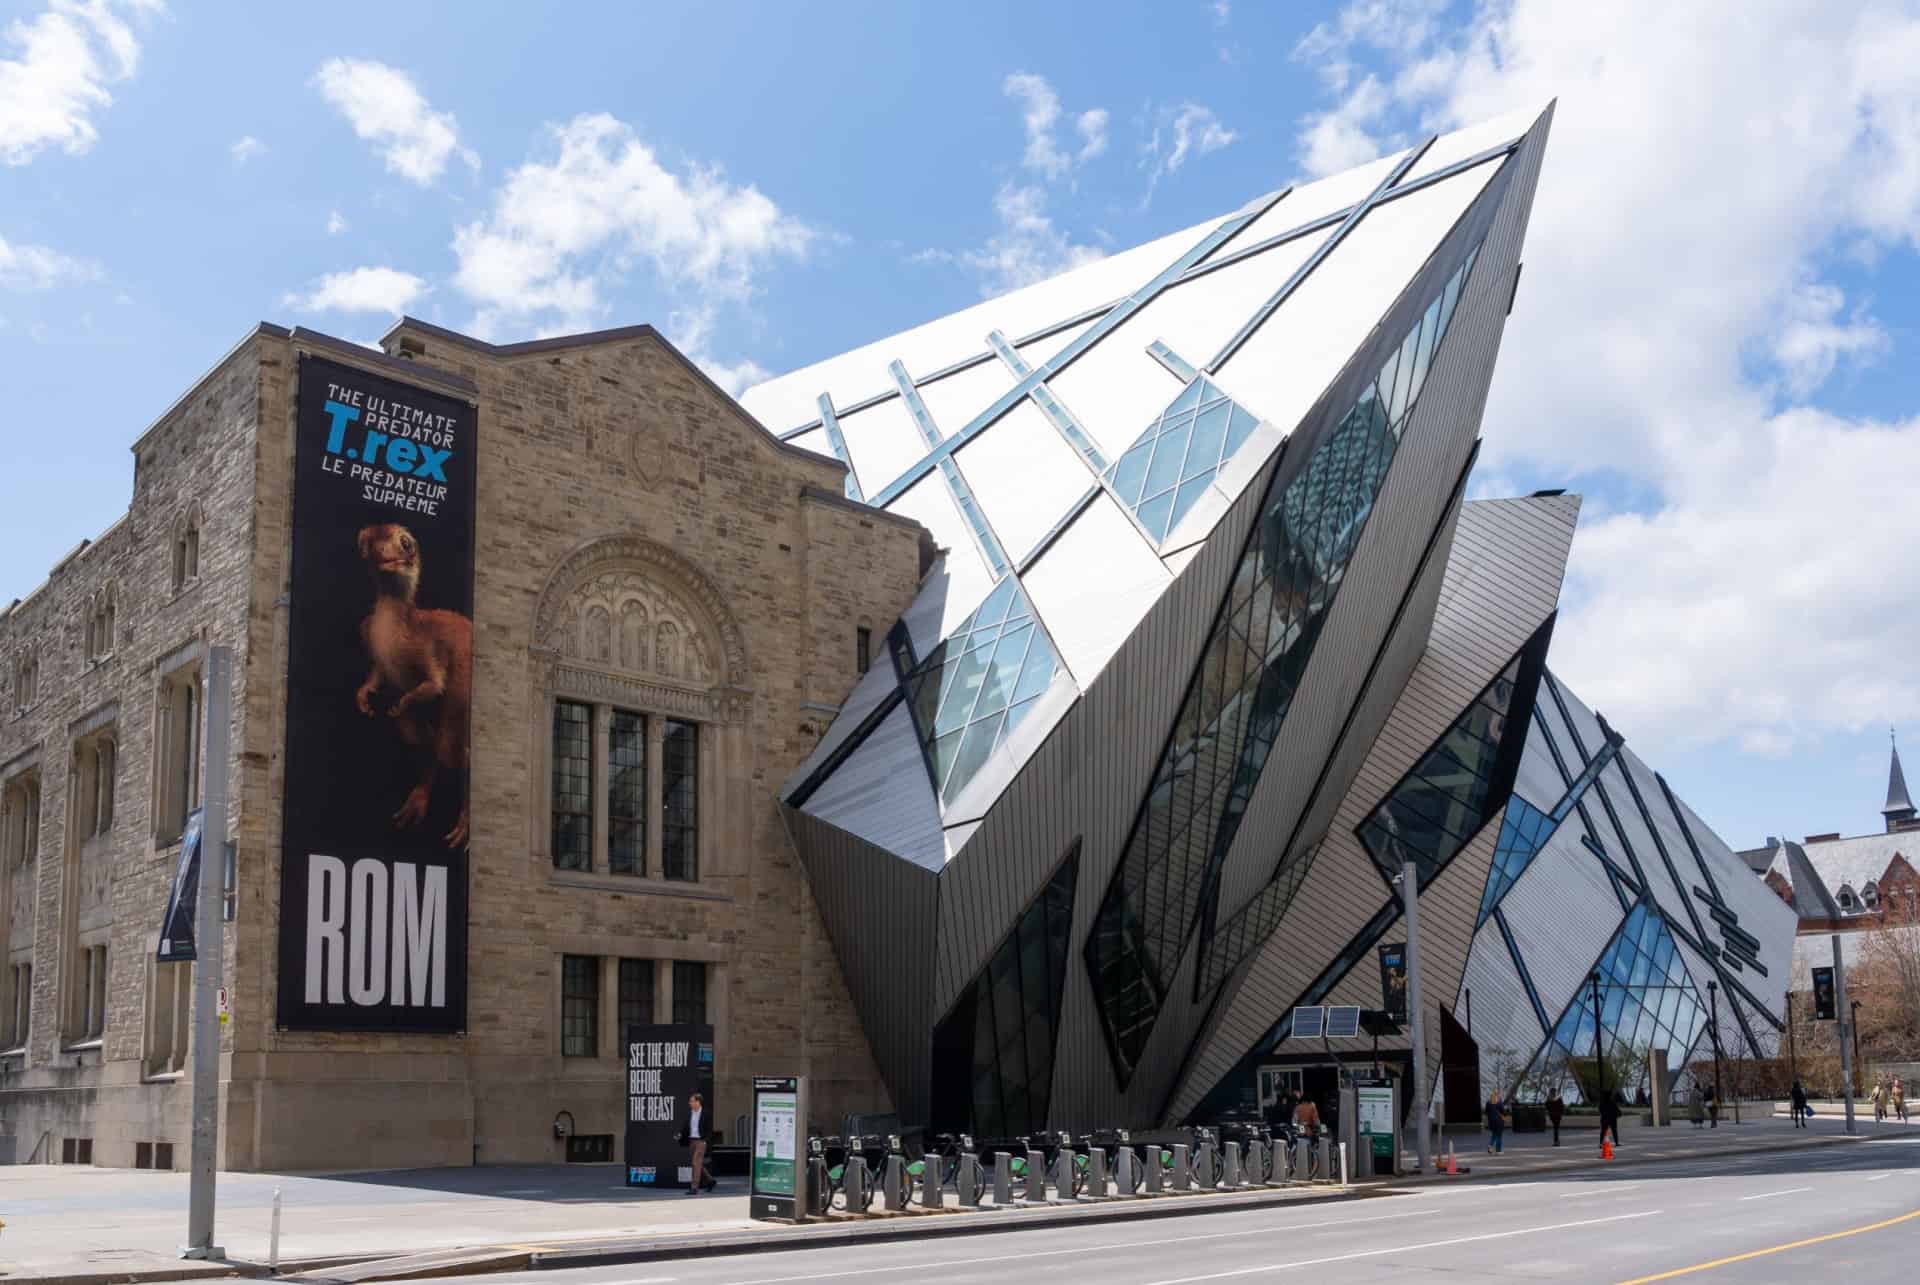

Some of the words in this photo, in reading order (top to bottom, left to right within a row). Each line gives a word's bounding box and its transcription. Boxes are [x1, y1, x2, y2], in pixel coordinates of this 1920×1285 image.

[328, 383, 364, 407] THE
[367, 396, 456, 433] ULTIMATE
[324, 400, 452, 482] T.rex
[365, 413, 453, 448] PREDATOR
[322, 456, 345, 474] LE
[350, 464, 447, 501] PRÉDATEUR
[362, 485, 438, 515] SUPRÊME
[305, 854, 448, 1007] ROM
[629, 1043, 646, 1068] SEE
[646, 1043, 663, 1067] THE
[664, 1042, 689, 1067] BABY
[630, 1069, 662, 1094] BEFORE
[630, 1097, 646, 1121] THE
[648, 1096, 675, 1121] BEAST
